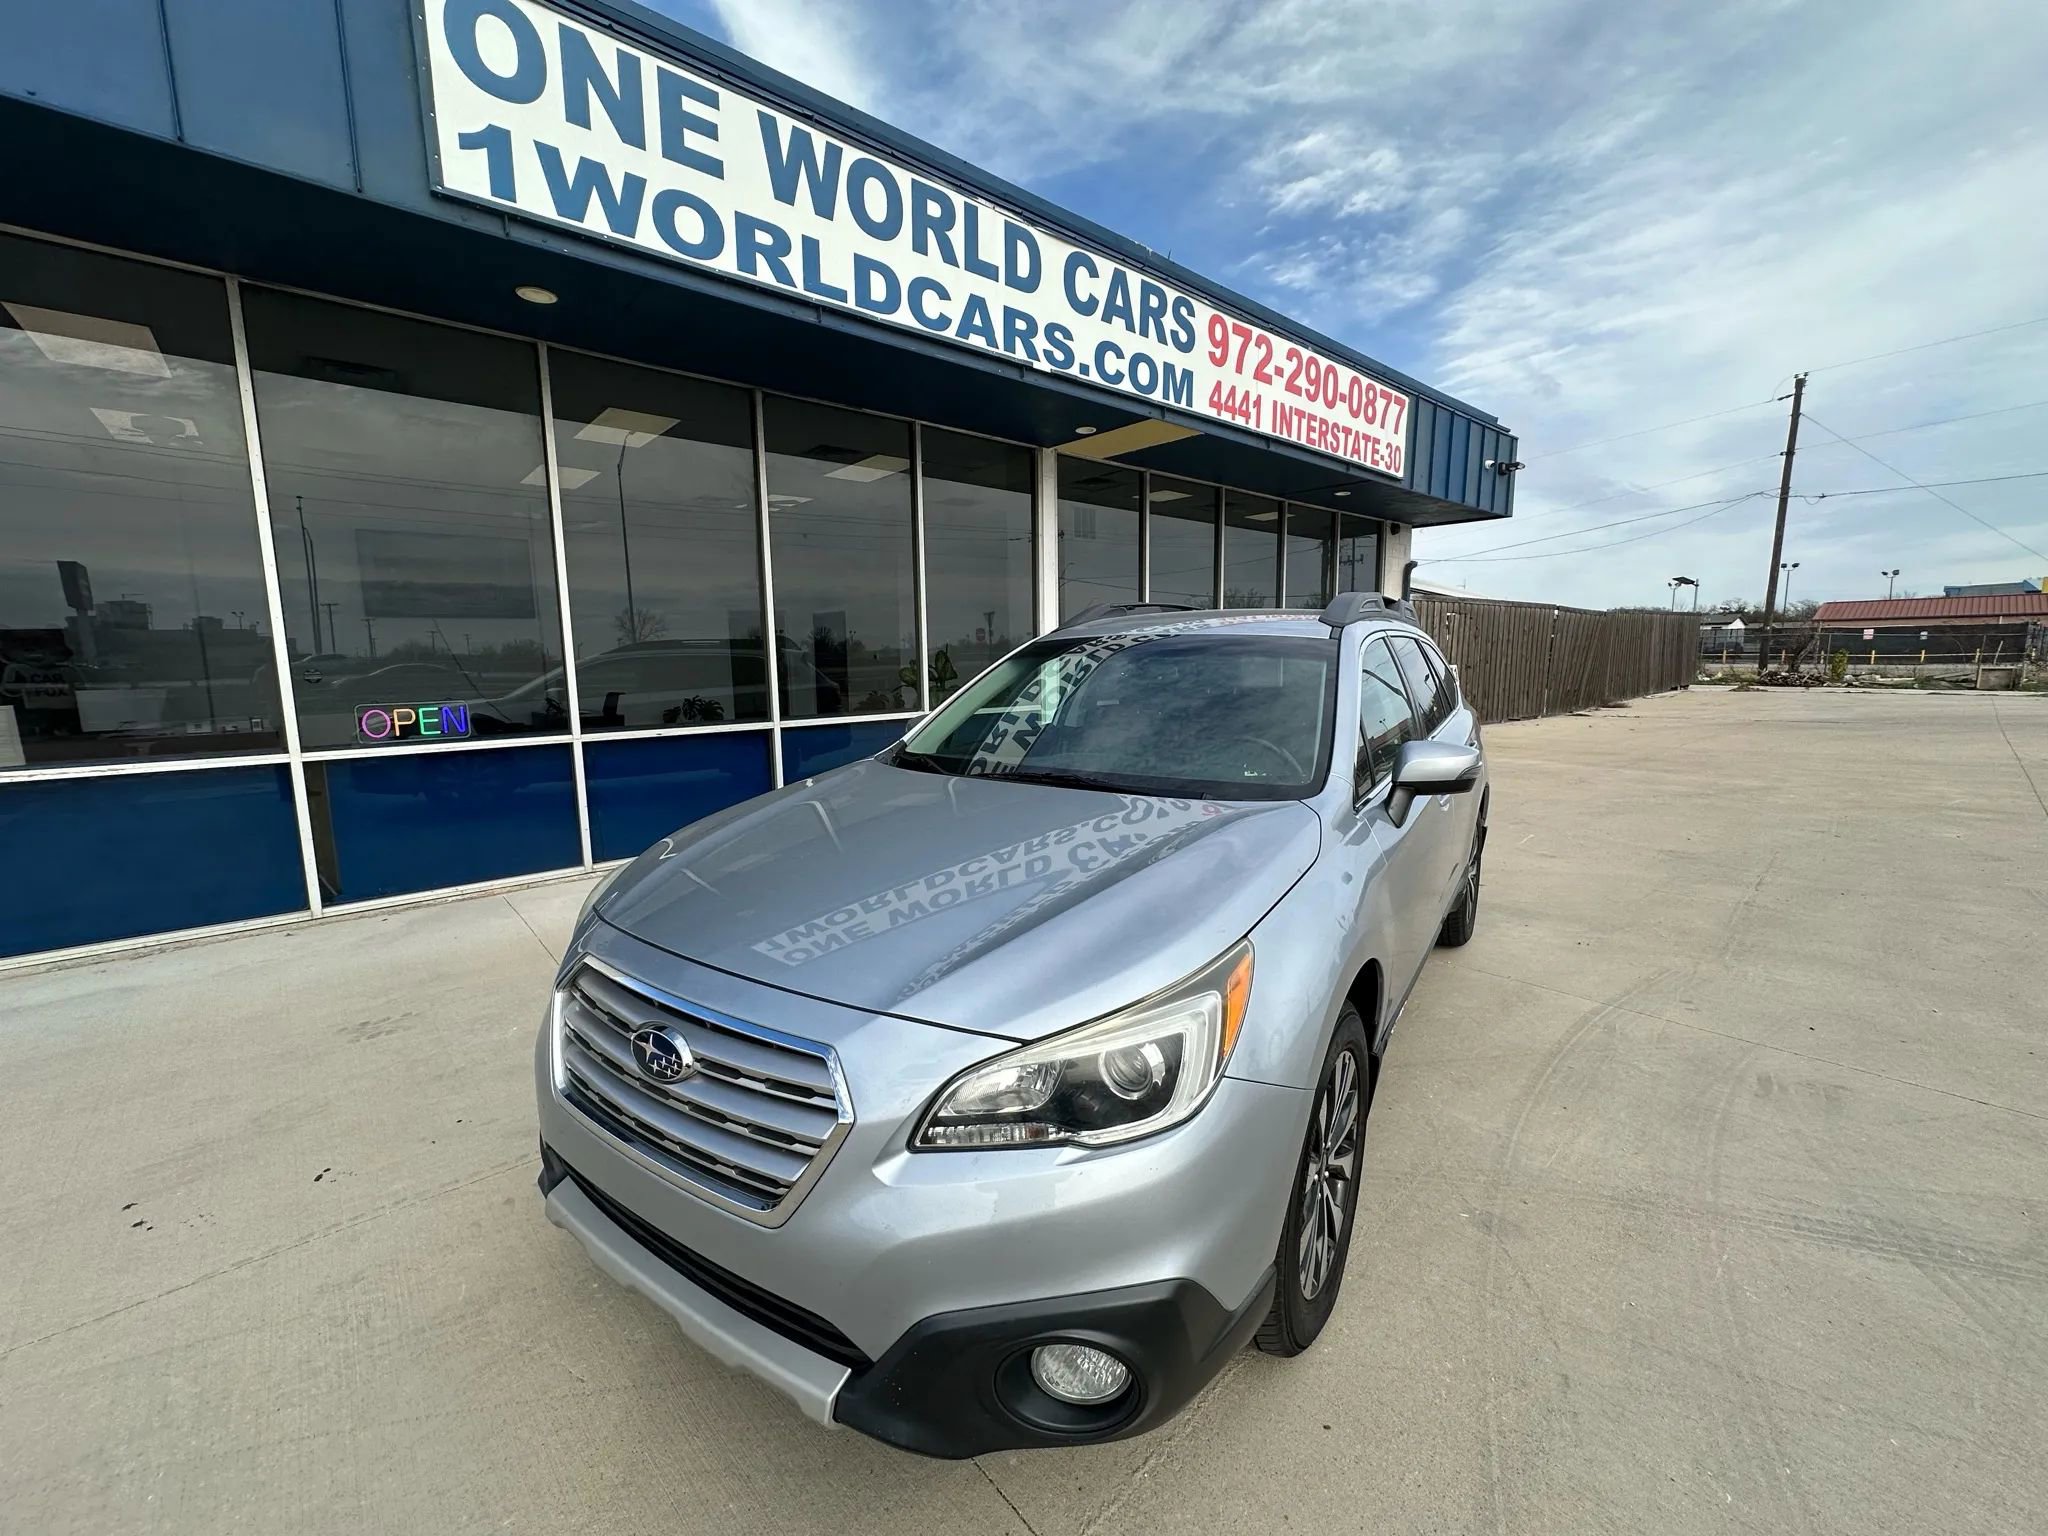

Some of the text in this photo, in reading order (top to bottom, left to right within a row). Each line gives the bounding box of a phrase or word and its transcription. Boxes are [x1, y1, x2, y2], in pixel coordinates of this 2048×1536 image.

[443, 0, 1197, 354] ONE WORLD CARS
[458, 123, 1195, 408] 1WORLDCARS.COM
[1207, 313, 1407, 435] 972-290-0877
[1208, 380, 1401, 474] 4441 INTERSTATE-30
[361, 705, 467, 739] OPEN
